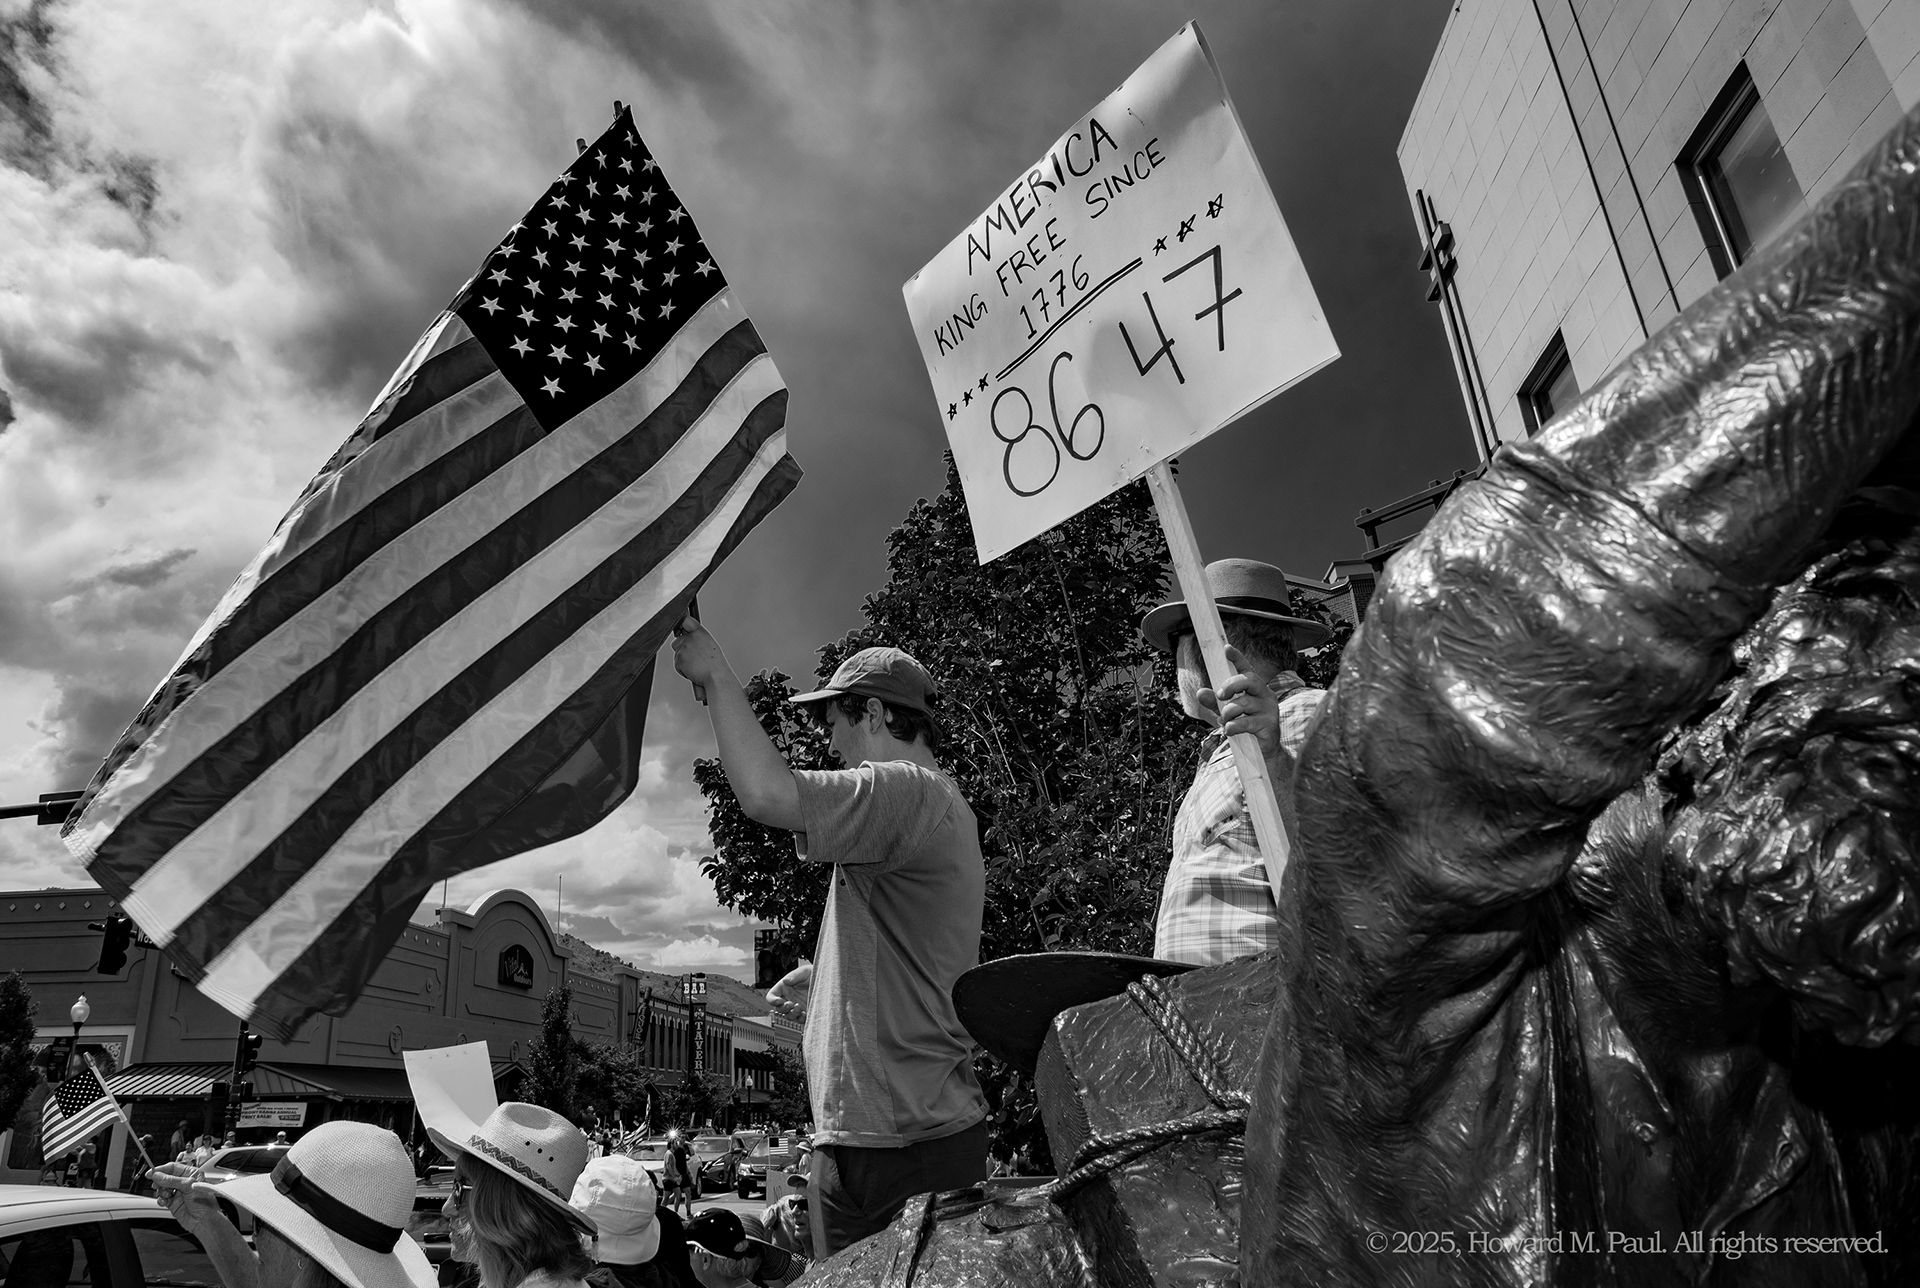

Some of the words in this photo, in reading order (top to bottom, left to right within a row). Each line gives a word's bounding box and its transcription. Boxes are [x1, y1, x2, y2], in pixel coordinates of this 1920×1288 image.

[934, 293, 989, 356] KING
[996, 218, 1067, 296] FREE
[1085, 138, 1166, 219] SINCE
[967, 118, 1118, 275] AMERICA
[991, 351, 1104, 497] 86
[1119, 245, 1243, 385] 47
[1019, 254, 1090, 339] 1776
[683, 982, 706, 994] BAR
